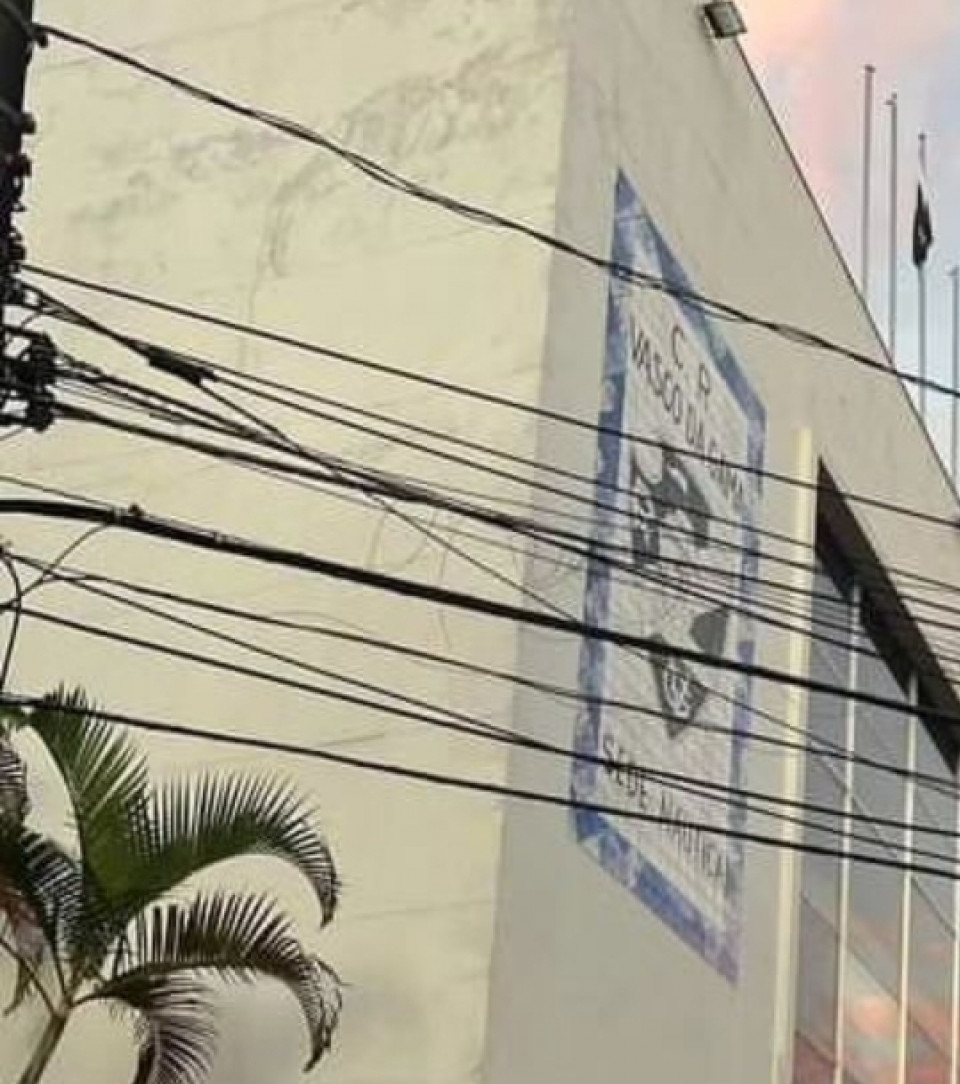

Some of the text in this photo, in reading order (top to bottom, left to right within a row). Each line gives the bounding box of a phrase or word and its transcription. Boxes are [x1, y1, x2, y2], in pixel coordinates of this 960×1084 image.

[629, 313, 683, 425] VASCO
[685, 401, 705, 452] DA
[602, 733, 647, 811] SEDE
